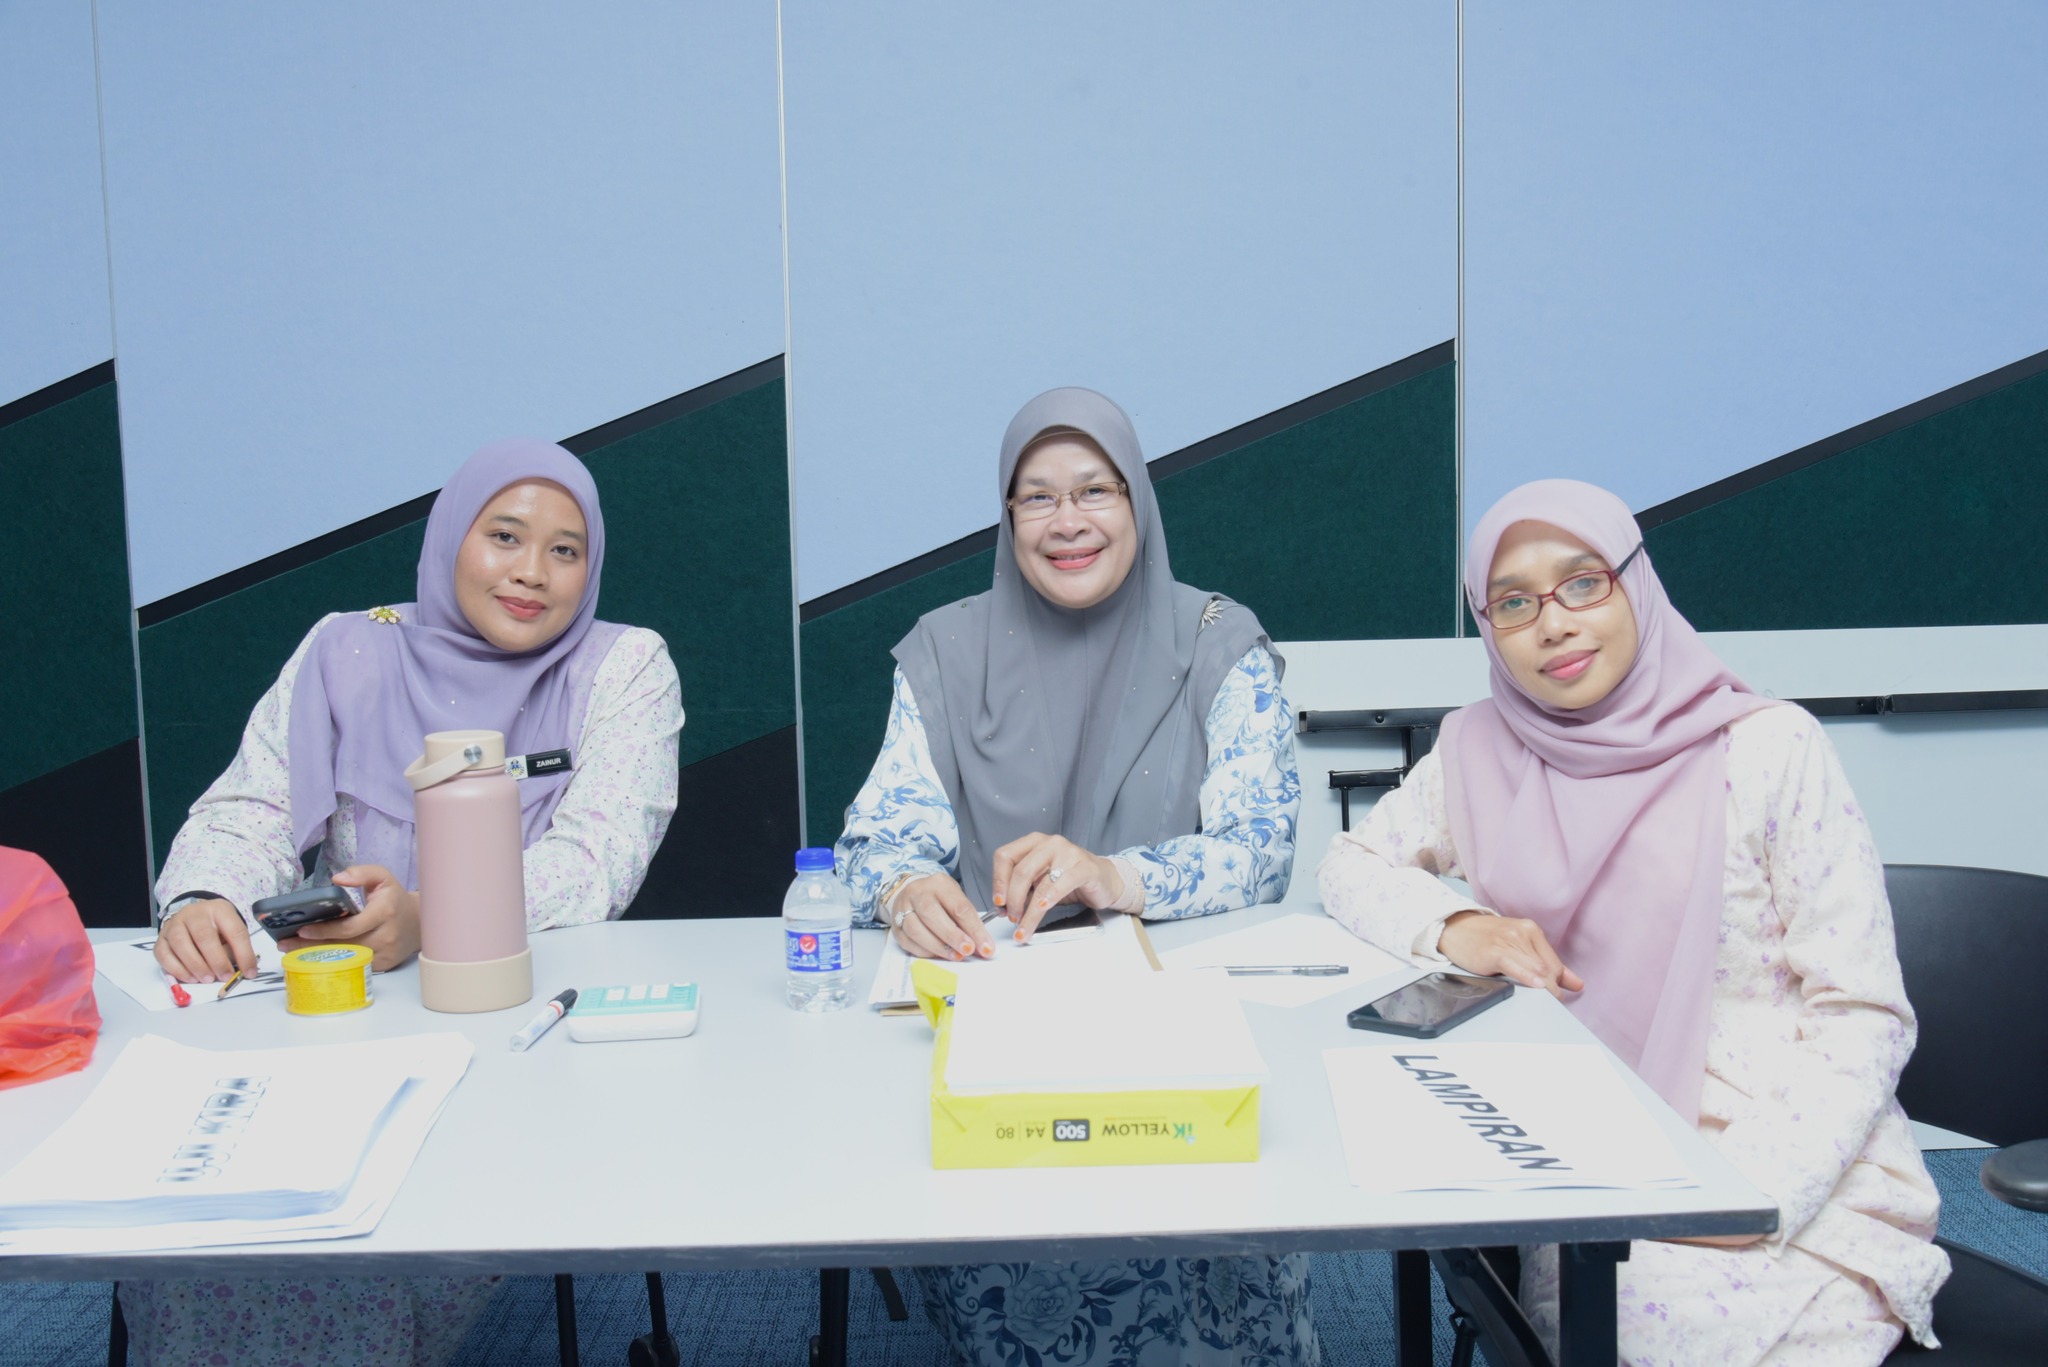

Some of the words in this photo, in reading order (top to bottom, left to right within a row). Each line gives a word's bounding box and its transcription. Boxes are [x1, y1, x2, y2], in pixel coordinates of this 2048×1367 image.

[536, 757, 562, 769] ZAINUR
[1392, 1055, 1574, 1170] LAMPIRAN
[996, 1127, 1015, 1139] 80
[1026, 1125, 1045, 1138] A4
[1055, 1124, 1087, 1140] 500
[1102, 1121, 1170, 1136] YELLOW
